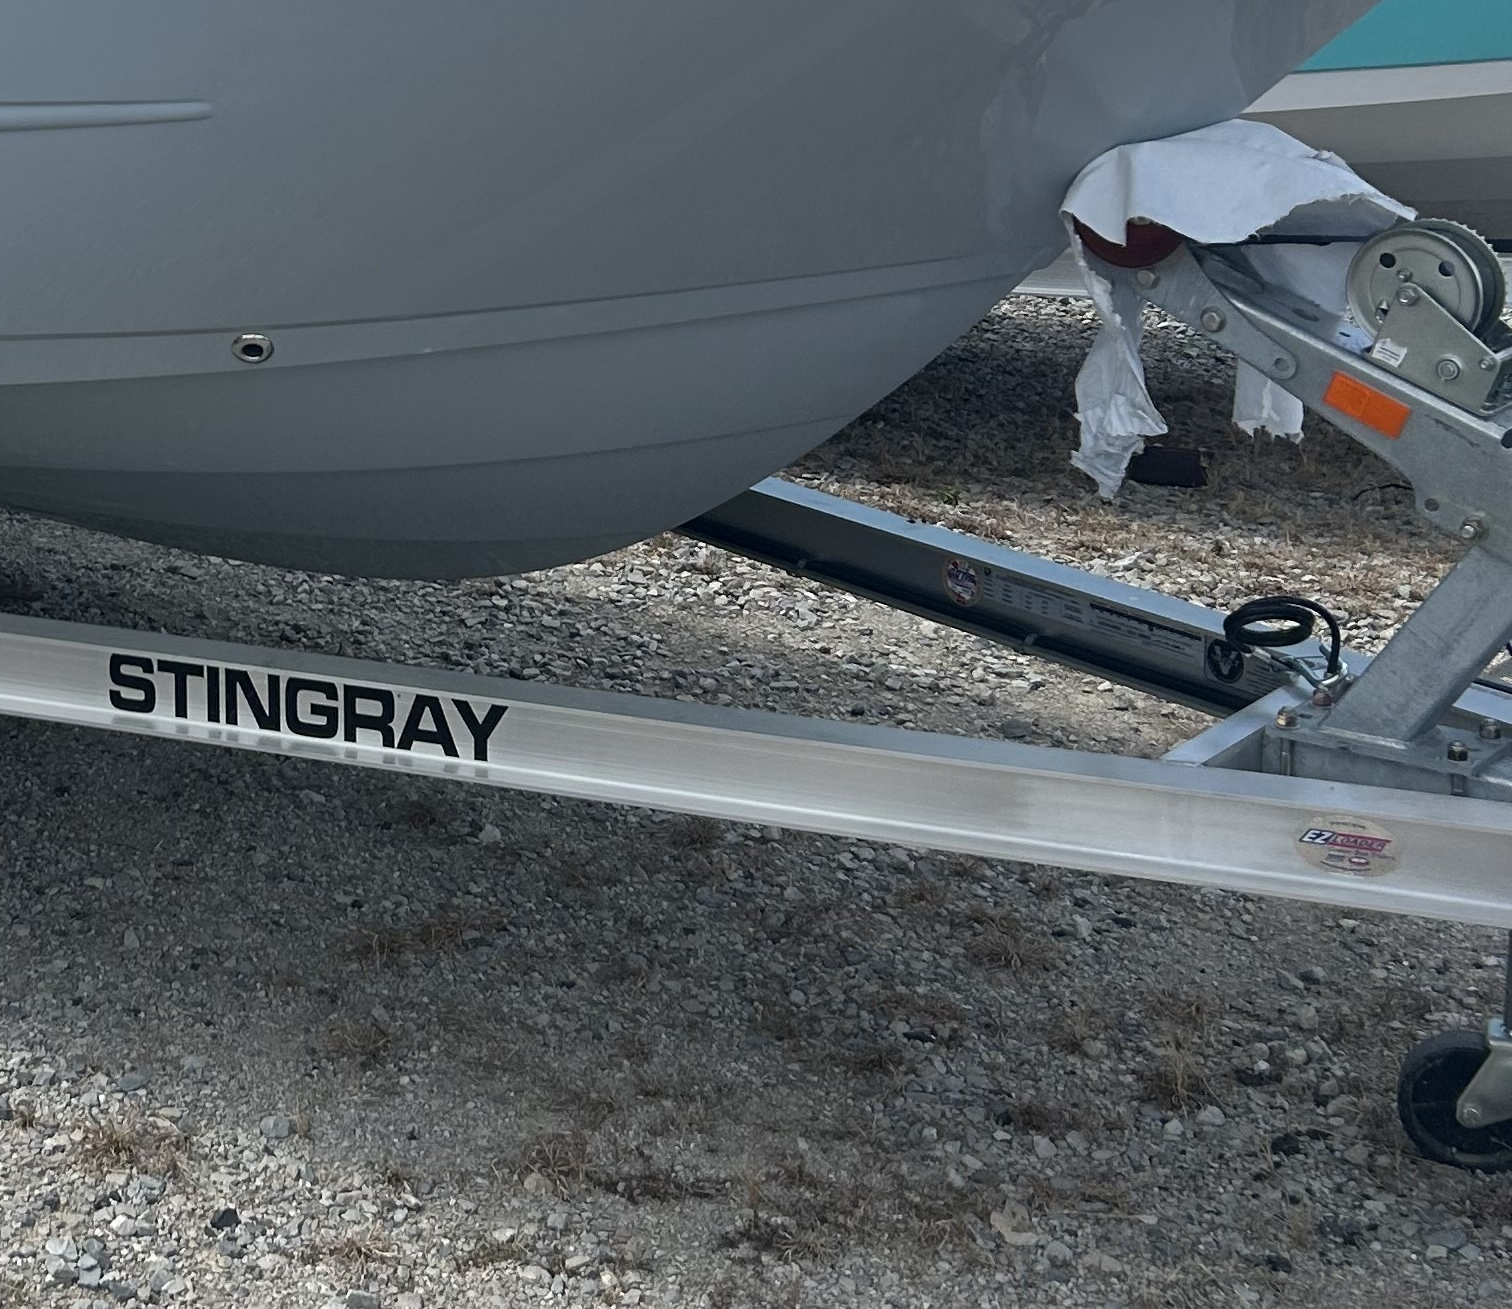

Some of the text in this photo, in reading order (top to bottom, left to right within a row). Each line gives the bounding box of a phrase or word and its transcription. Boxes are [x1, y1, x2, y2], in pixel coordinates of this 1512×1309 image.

[108, 652, 509, 762] STINGRAY
[1299, 829, 1389, 851] EZ LOADER
